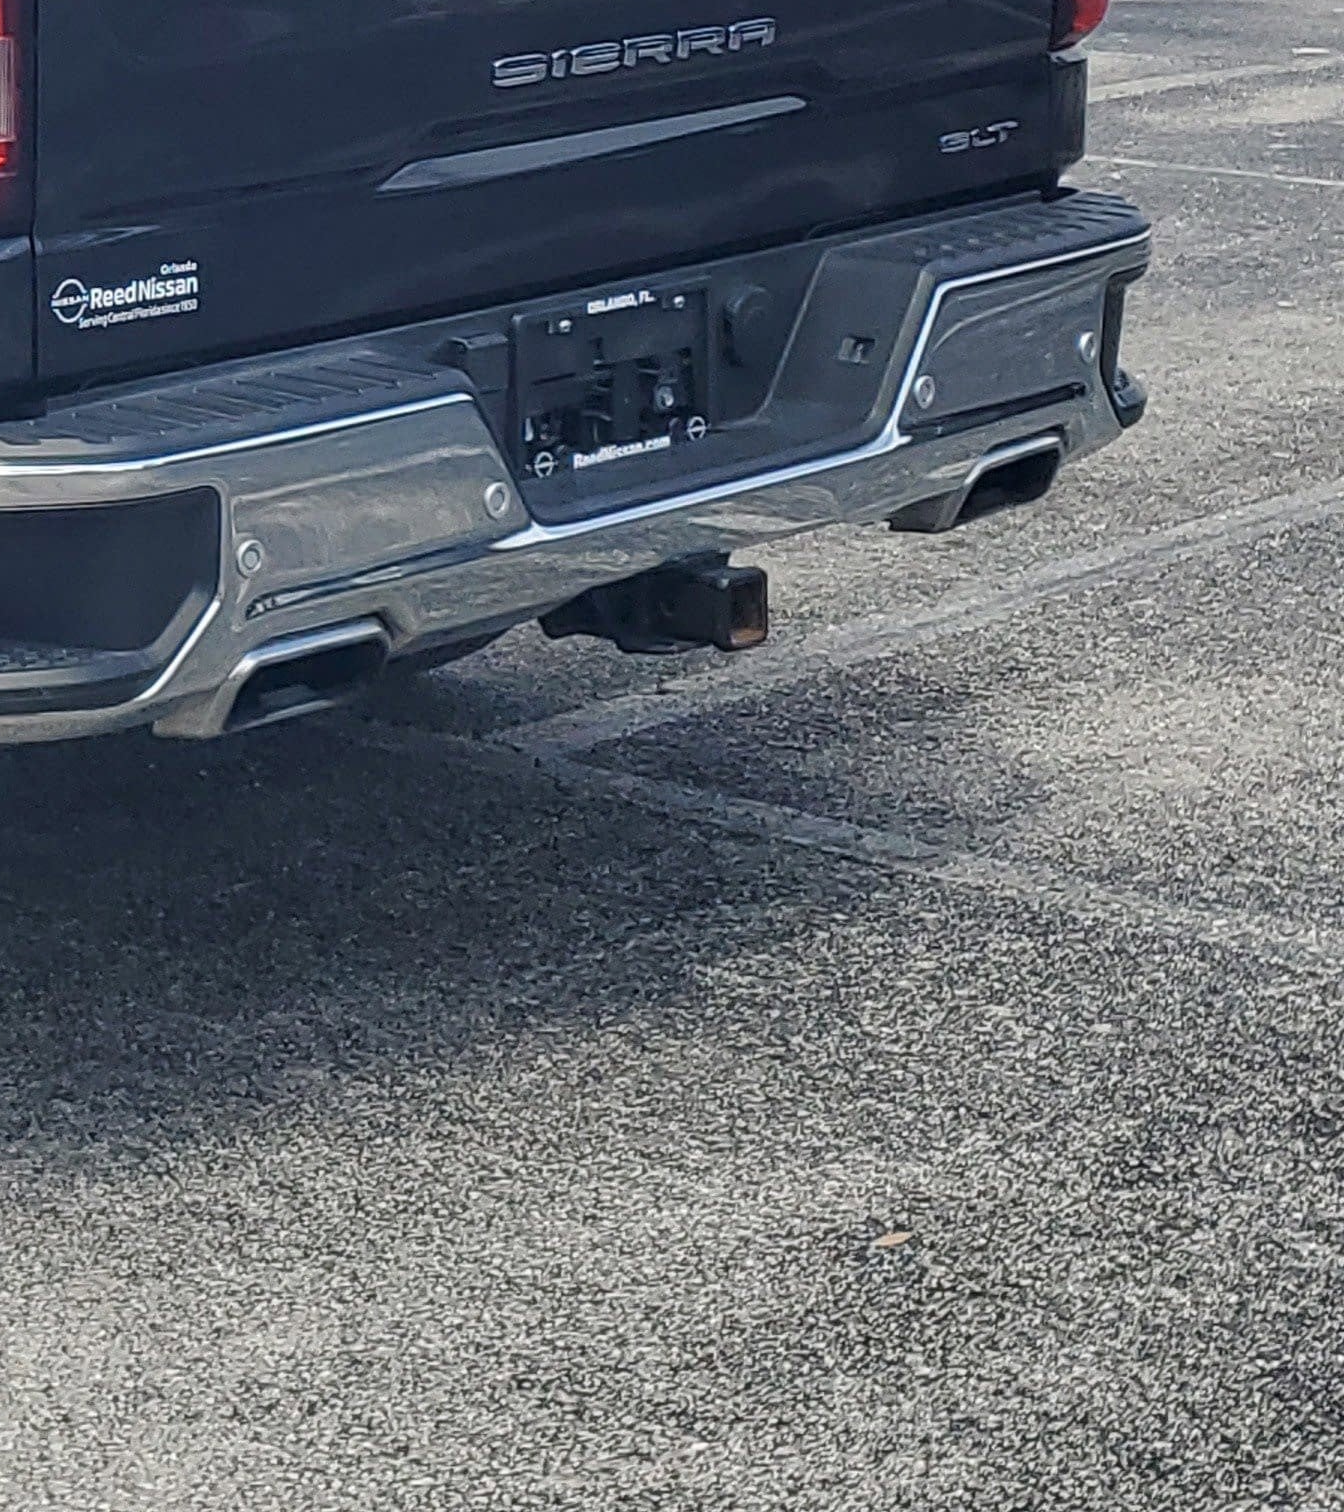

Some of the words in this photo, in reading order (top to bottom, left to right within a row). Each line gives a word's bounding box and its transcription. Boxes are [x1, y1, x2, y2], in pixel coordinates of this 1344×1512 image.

[491, 17, 776, 87] SIERRA
[939, 120, 1019, 153] SLT
[159, 260, 198, 275] Orlando
